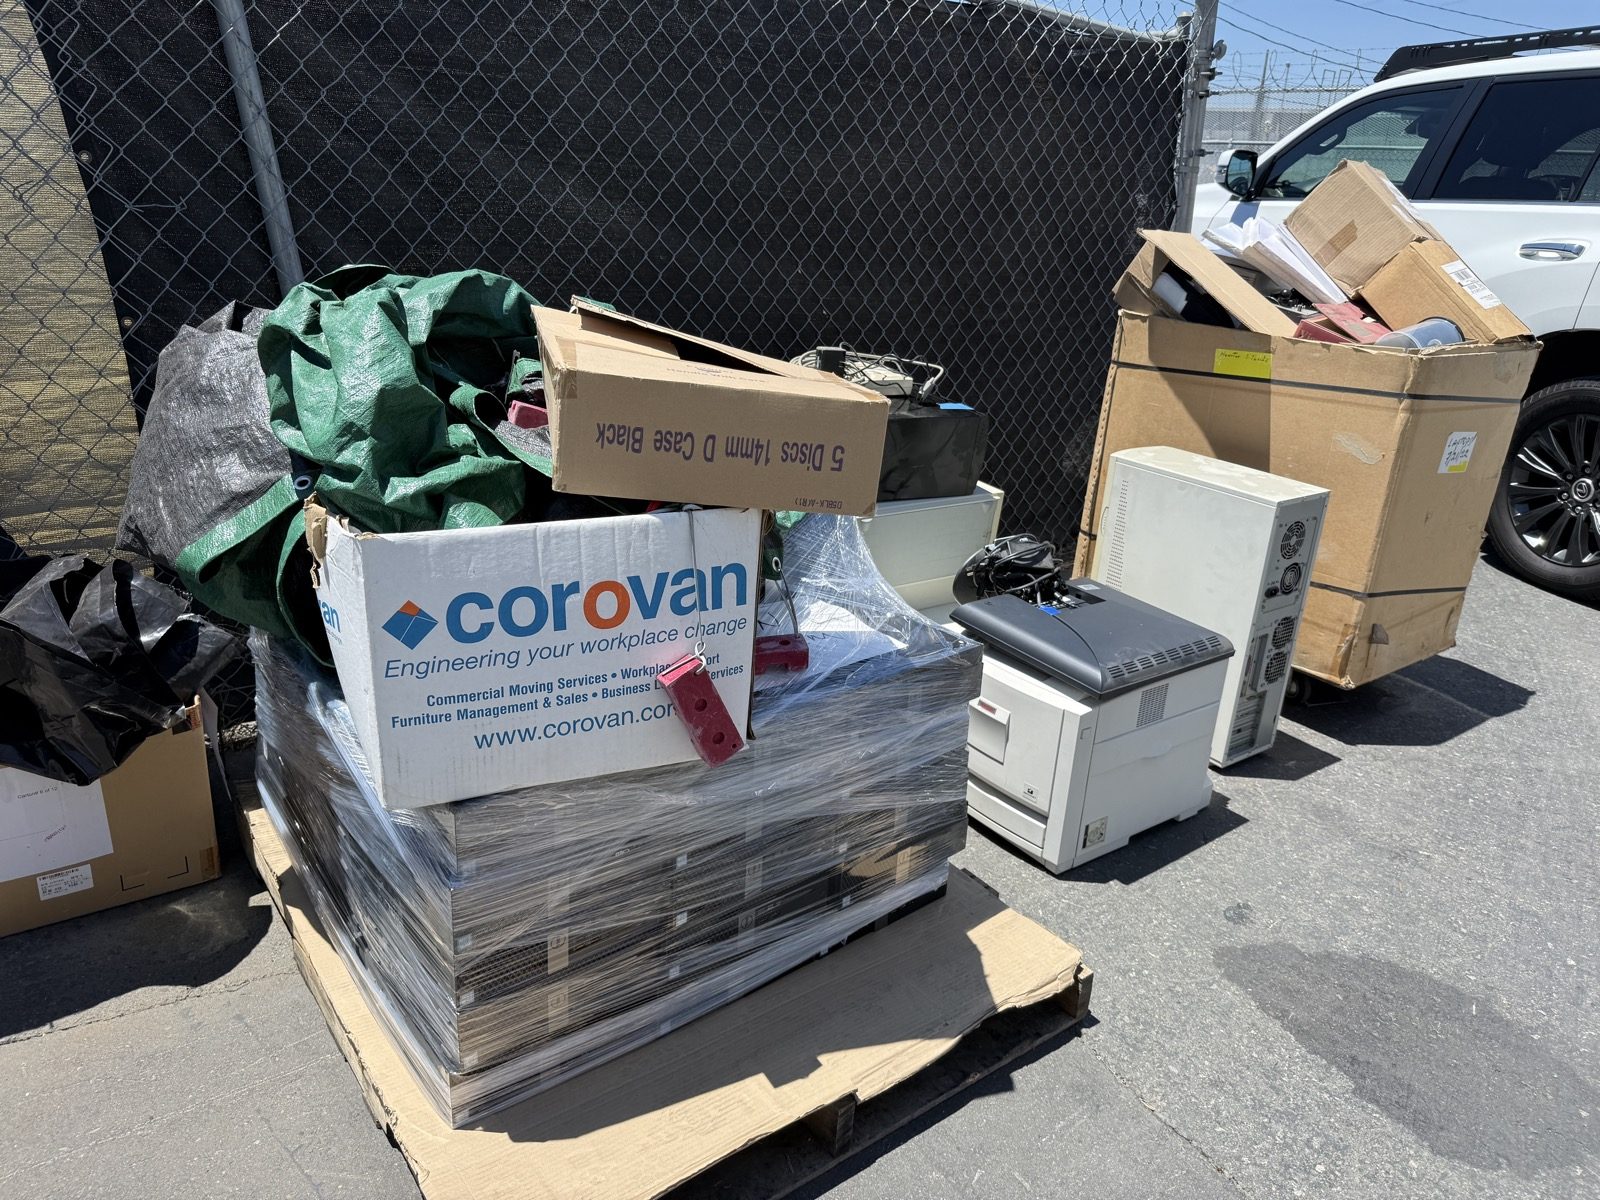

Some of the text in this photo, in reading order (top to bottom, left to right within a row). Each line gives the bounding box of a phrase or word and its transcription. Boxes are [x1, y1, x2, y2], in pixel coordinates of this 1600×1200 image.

[596, 422, 845, 473] 5 Discs 14mm D Case Black
[445, 562, 748, 644] corovan
[384, 616, 748, 680] Engineering your workplace change
[391, 711, 452, 729] Furniture
[456, 699, 539, 721] Management
[542, 696, 552, 708] &
[556, 691, 589, 707] Sales
[601, 681, 651, 700] Business
[708, 664, 745, 681] ervices
[426, 686, 505, 707] Commercial
[509, 680, 554, 697] Moving
[557, 671, 608, 691] Services
